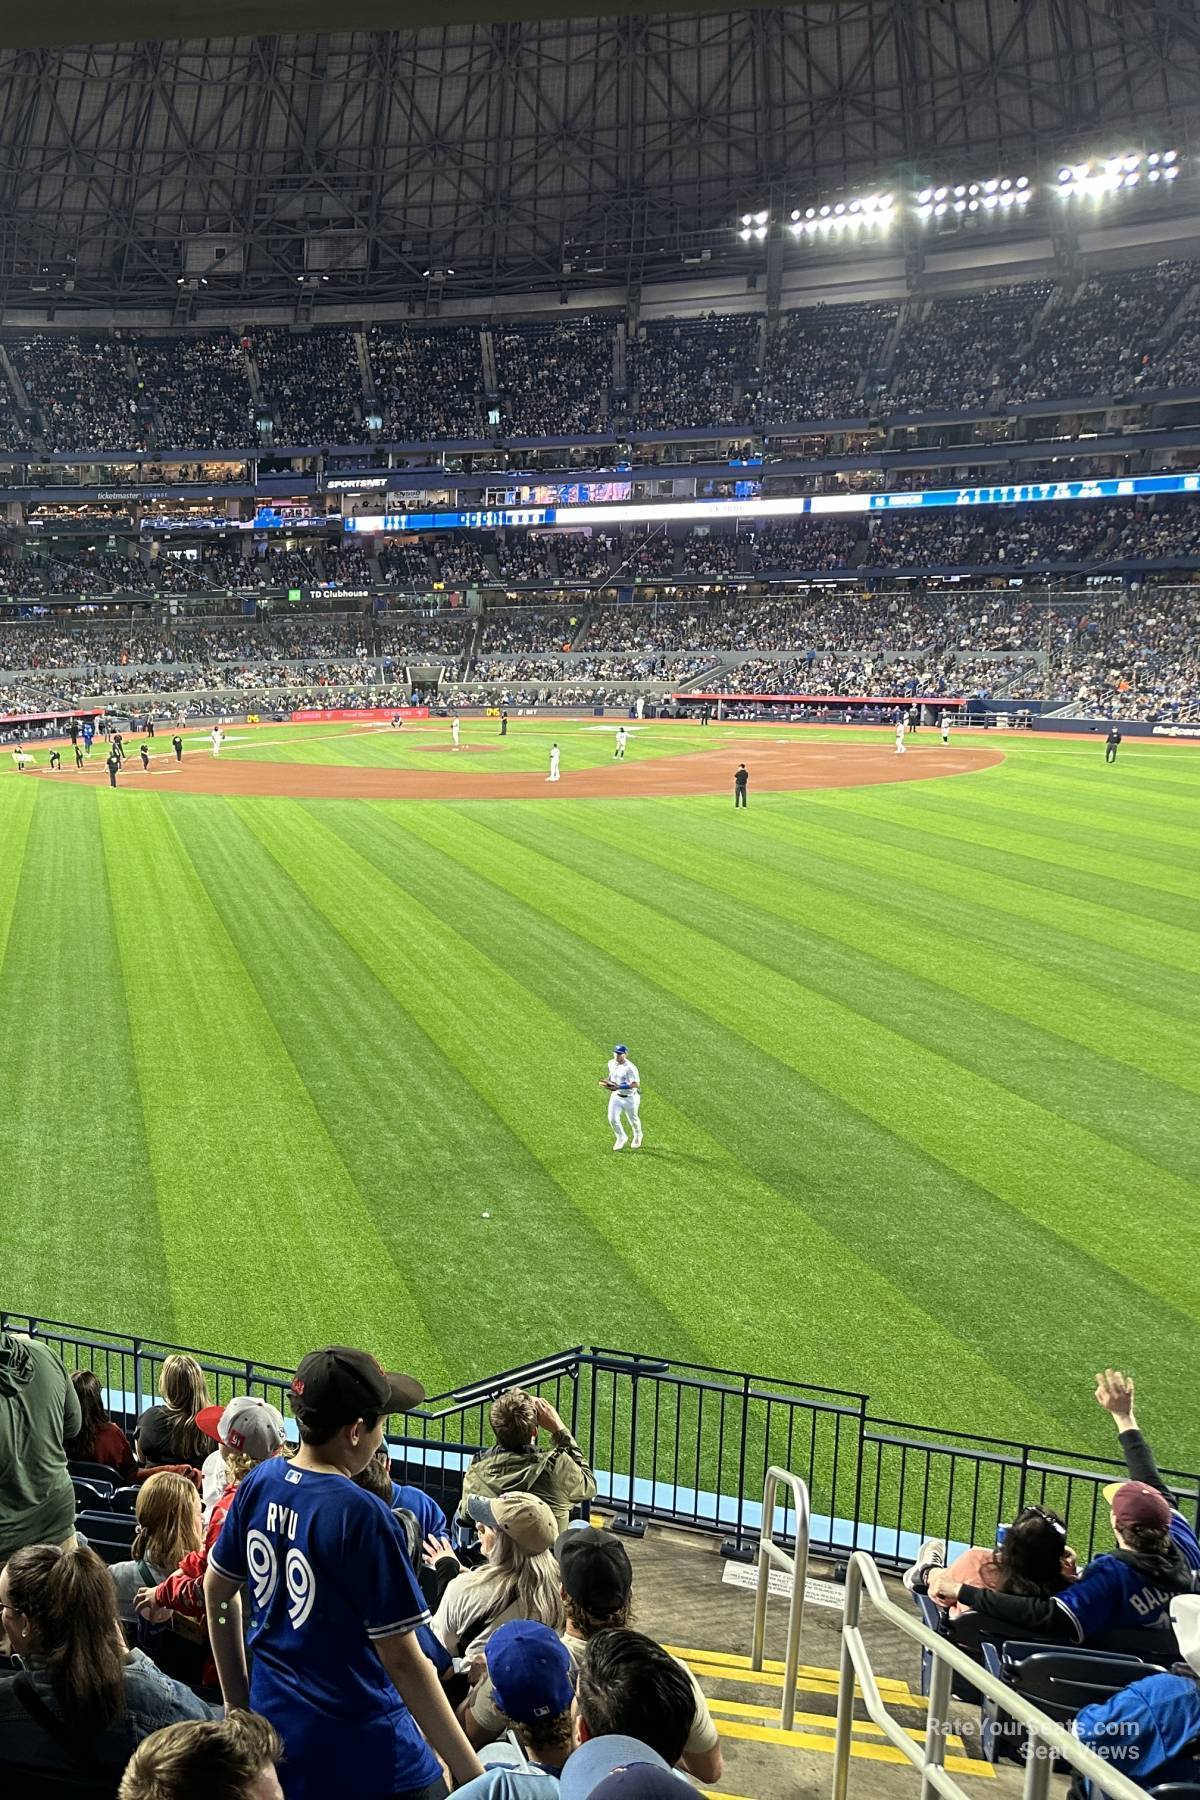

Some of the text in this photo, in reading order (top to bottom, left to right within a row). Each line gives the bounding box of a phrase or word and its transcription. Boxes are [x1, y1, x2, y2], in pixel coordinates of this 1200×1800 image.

[327, 478, 387, 489] SPORTSNET
[97, 491, 141, 500] ticketmaster
[323, 590, 369, 598] Clubhouse
[266, 1502, 299, 1541] RYU
[246, 1529, 316, 1630] 99
